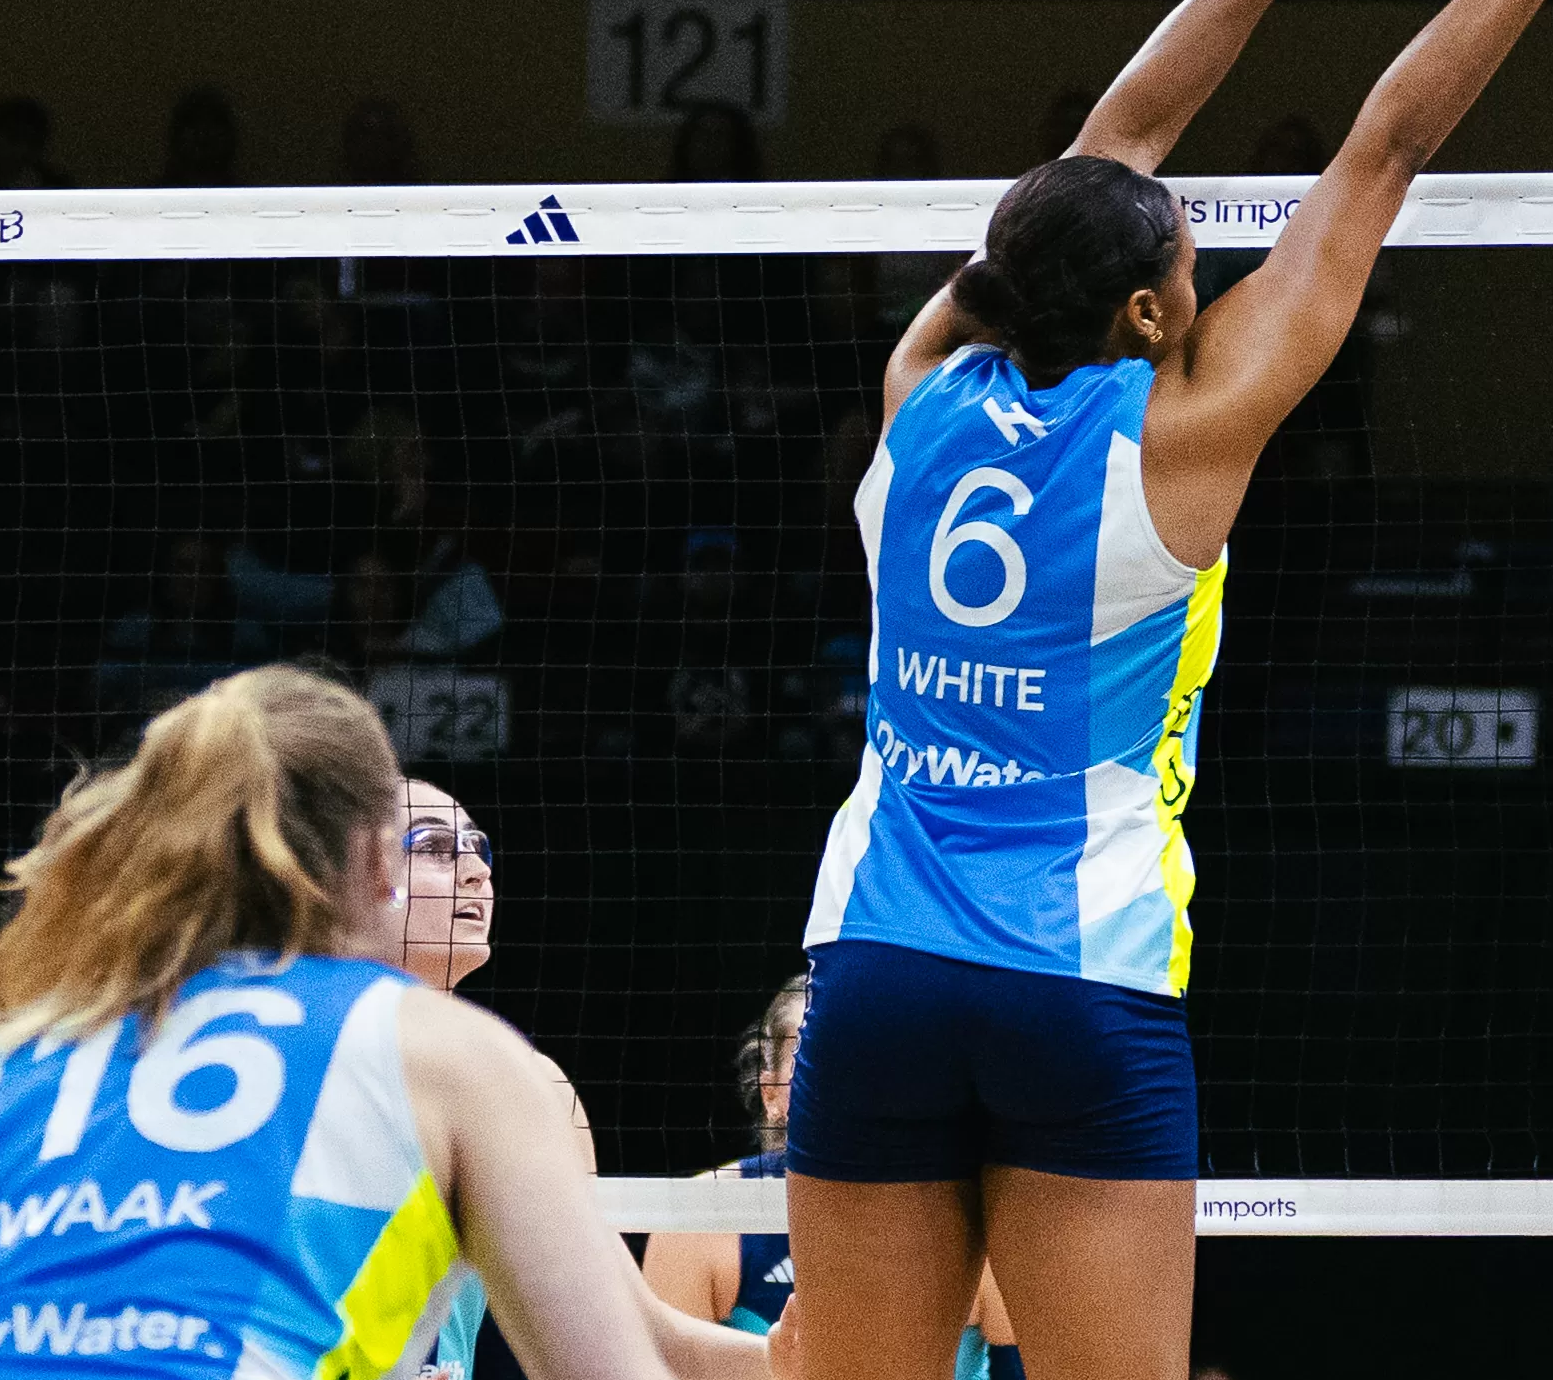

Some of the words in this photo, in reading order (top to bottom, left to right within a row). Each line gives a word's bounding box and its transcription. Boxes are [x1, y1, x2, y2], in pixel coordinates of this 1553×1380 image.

[611, 8, 768, 109] 121
[929, 466, 1035, 627] 6
[897, 646, 1047, 713] WHITE
[1403, 709, 1474, 755] 20
[31, 985, 307, 1163] 16
[1203, 1198, 1297, 1221] imports
